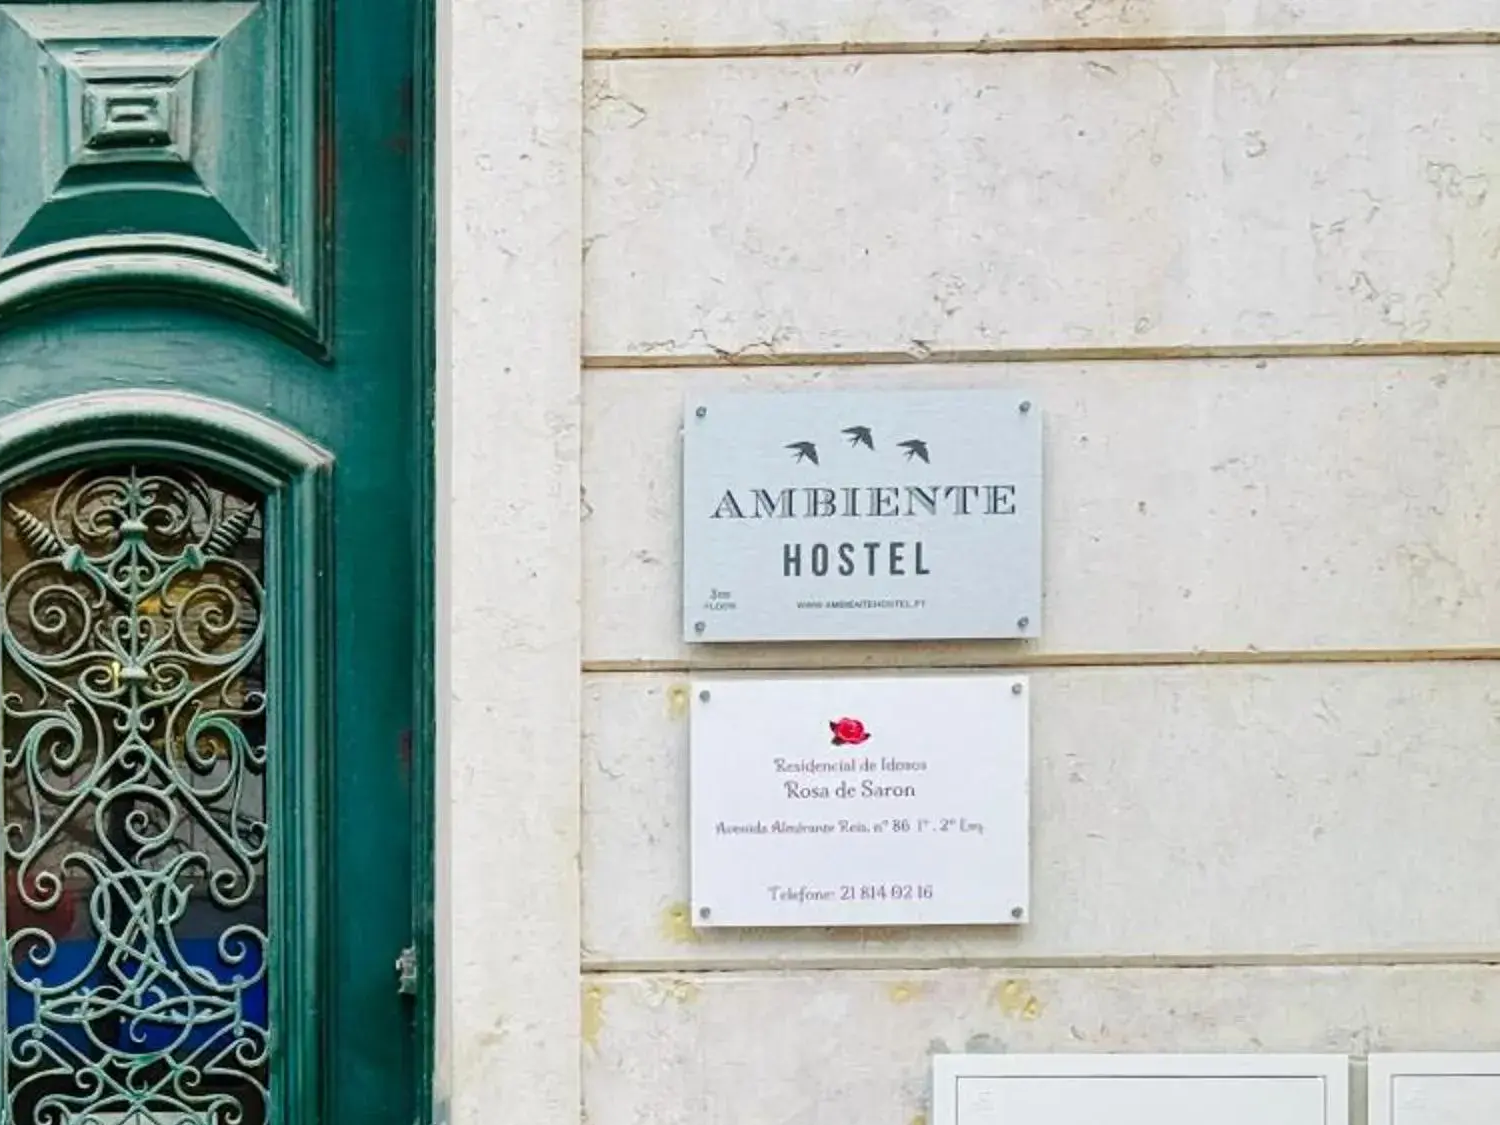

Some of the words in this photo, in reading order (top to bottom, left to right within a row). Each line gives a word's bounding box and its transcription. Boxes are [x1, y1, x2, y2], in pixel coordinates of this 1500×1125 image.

[709, 484, 1017, 519] AMBIENTE
[782, 541, 931, 577] HOSTEL
[773, 757, 856, 775] Residencial
[860, 757, 877, 772] de
[881, 756, 928, 772] Idosos
[784, 780, 830, 799] Rosa
[835, 780, 857, 798] de
[861, 779, 916, 798] Saron
[891, 818, 911, 833] 86
[839, 885, 855, 901] 21
[859, 885, 886, 901] 814
[891, 884, 913, 900] 02
[916, 884, 932, 899] 16
